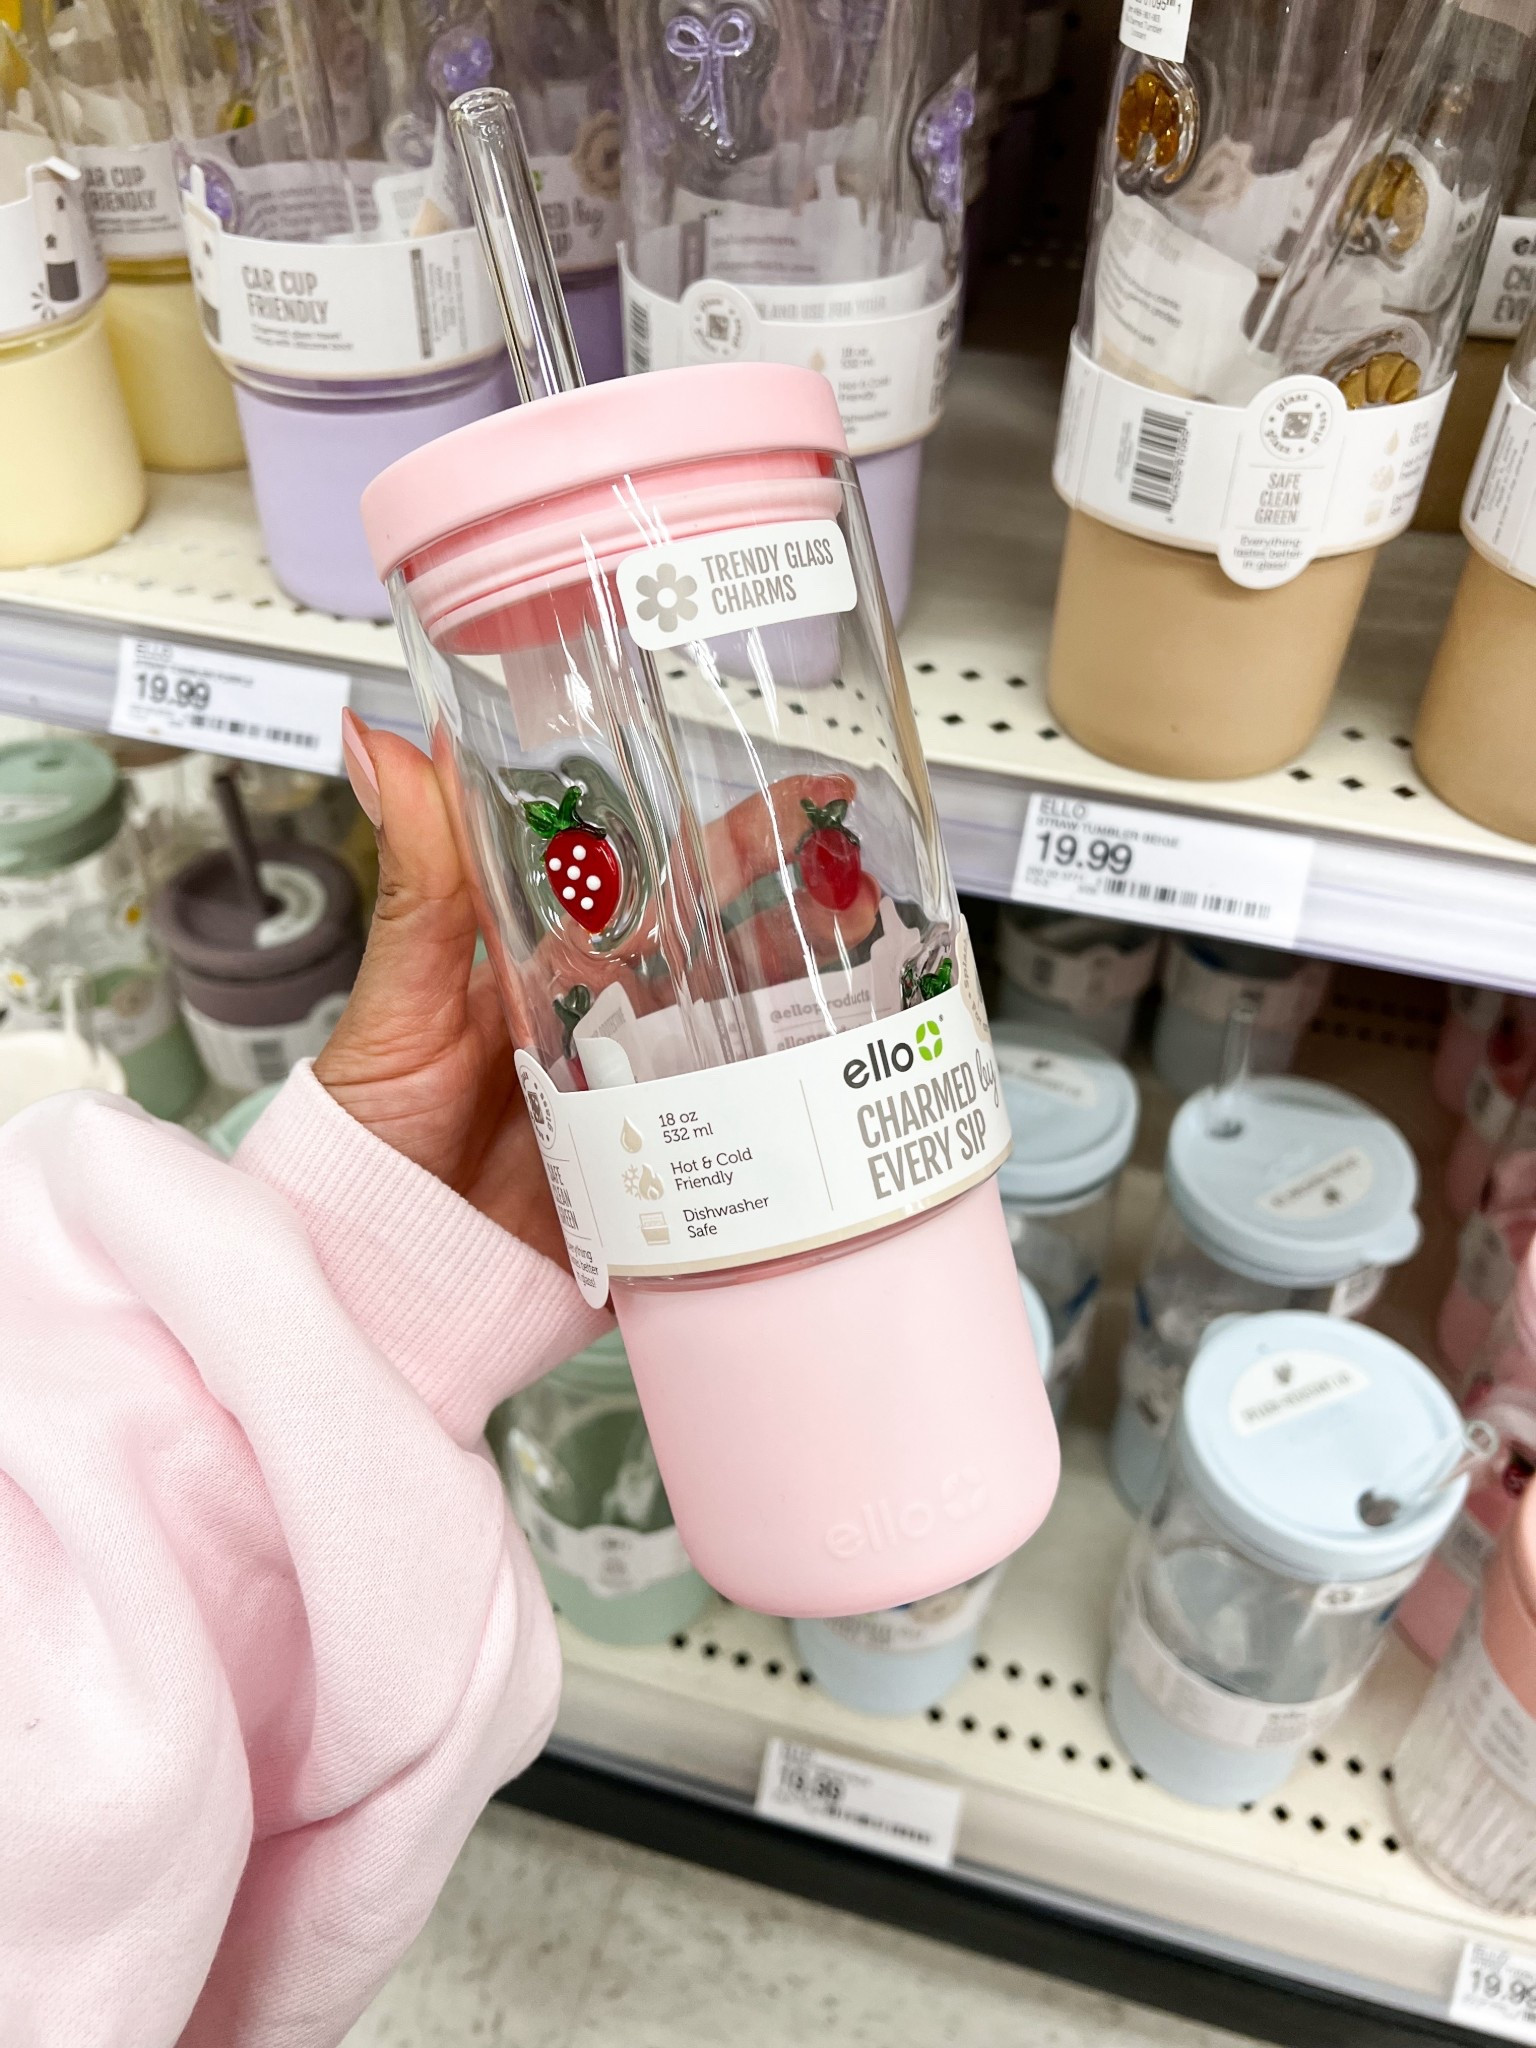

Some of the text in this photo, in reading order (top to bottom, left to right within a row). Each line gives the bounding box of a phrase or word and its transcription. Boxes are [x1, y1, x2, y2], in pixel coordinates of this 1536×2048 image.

[241, 264, 318, 297] CAR CUP
[246, 292, 329, 325] FRIENDLY
[1267, 472, 1302, 490] SAFE
[1259, 490, 1302, 508] CLEAN
[1254, 509, 1299, 526] GREEN
[701, 538, 833, 584] TRENDY GLASS
[711, 574, 797, 615] CHARMS
[136, 673, 211, 710] 19.99
[1039, 798, 1087, 819] ELLO
[1036, 816, 1180, 848] STRAW TUMBLER BEIGE
[1036, 831, 1133, 875] 19.99
[843, 1038, 914, 1089] ello
[857, 1061, 977, 1149] CHARMED
[975, 1048, 999, 1108] by
[659, 1111, 698, 1128] 18 oz
[663, 1122, 714, 1144] 532 ml
[670, 1147, 753, 1175] Hot & Cold
[867, 1108, 986, 1200] EVERY SIP
[674, 1170, 734, 1191] Friendly
[683, 1196, 769, 1222] Dishwasher
[687, 1223, 718, 1239] Safe
[824, 1499, 935, 1560] ello
